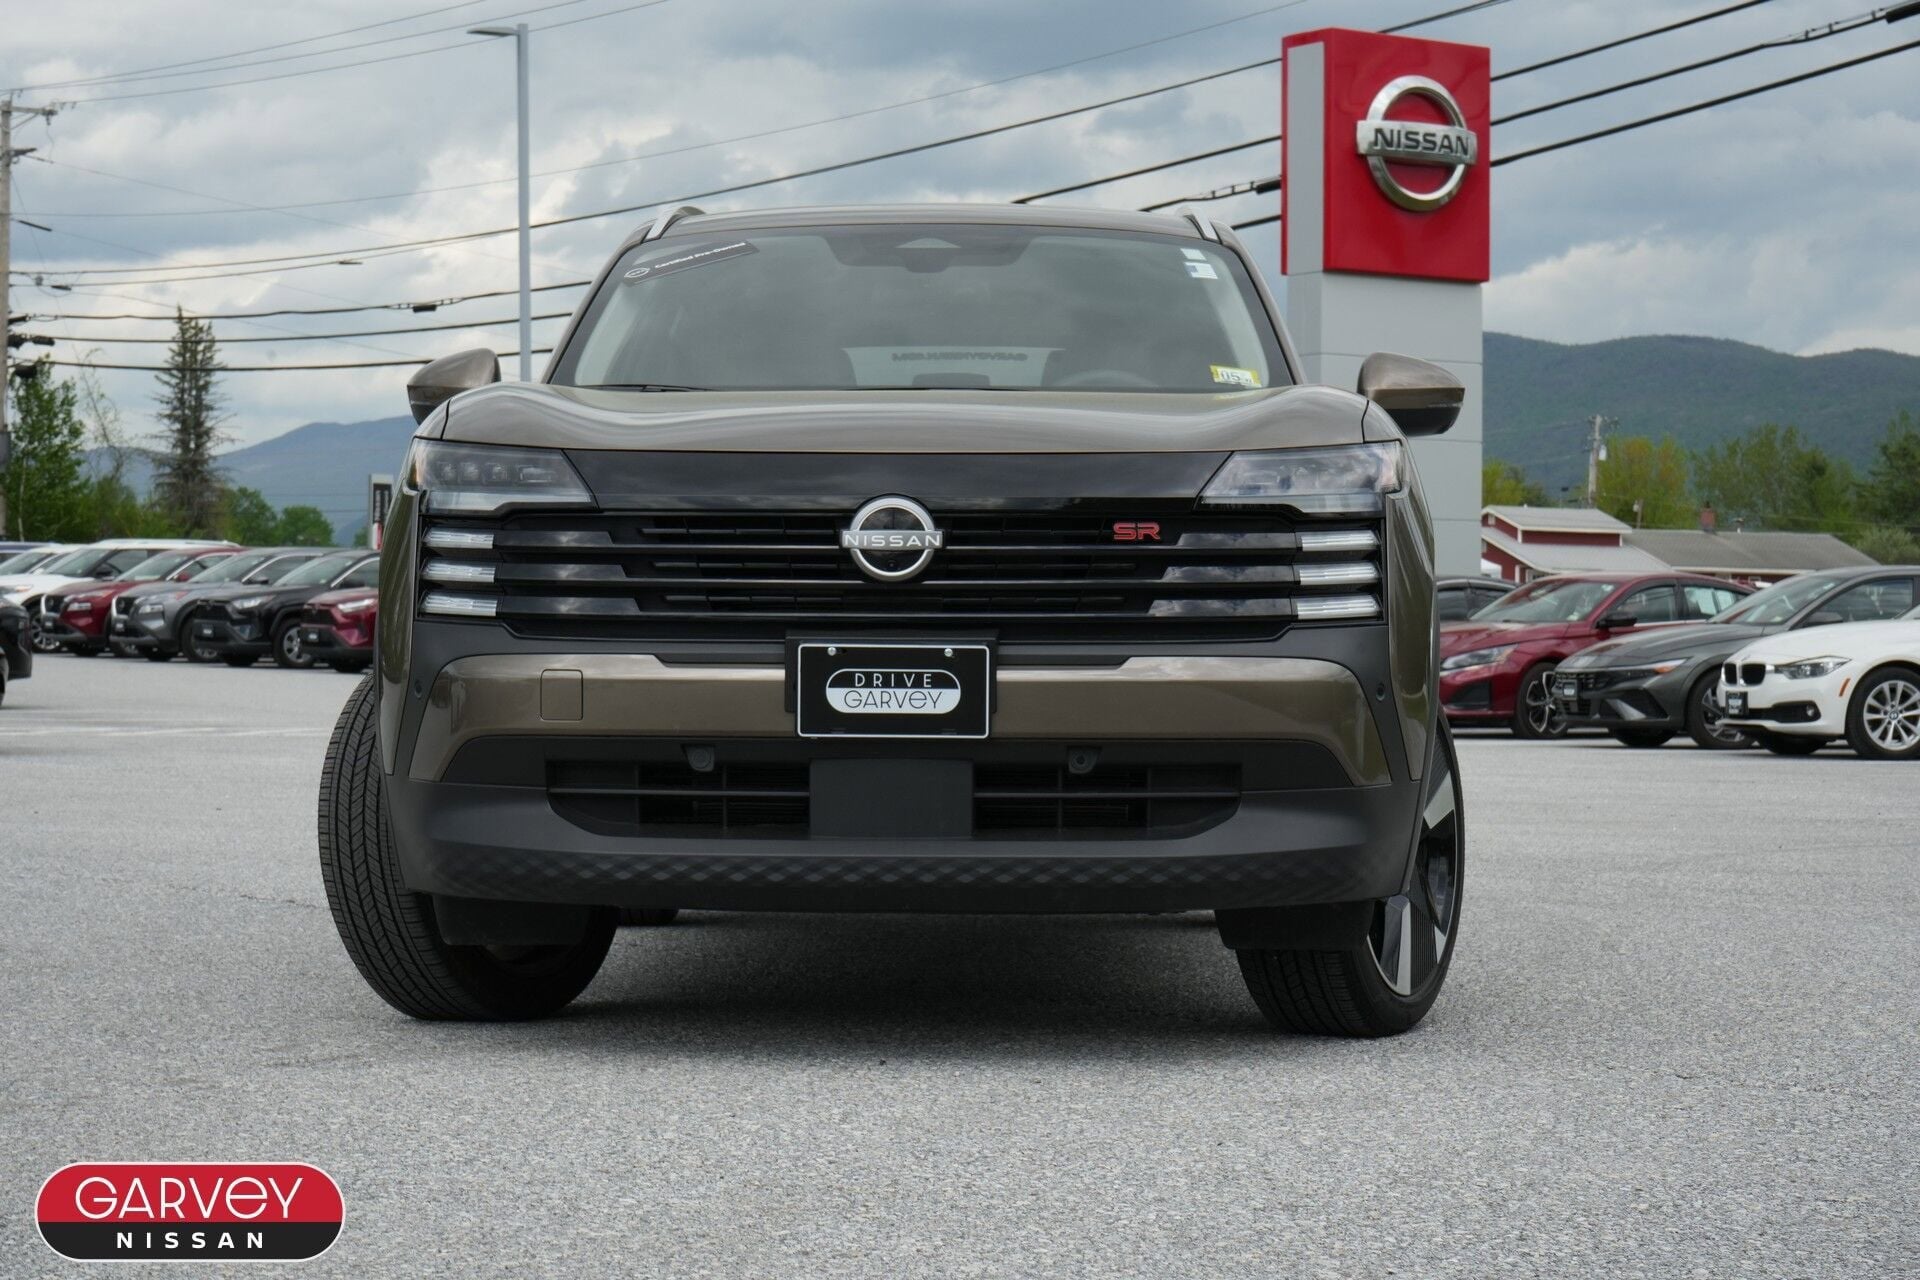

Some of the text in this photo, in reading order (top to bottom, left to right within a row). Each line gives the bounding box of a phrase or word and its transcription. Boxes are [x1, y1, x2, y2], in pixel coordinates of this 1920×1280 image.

[1374, 128, 1469, 156] NISSAN
[1113, 521, 1160, 540] SR
[845, 533, 941, 547] NISSAN
[855, 673, 932, 688] DRIVE
